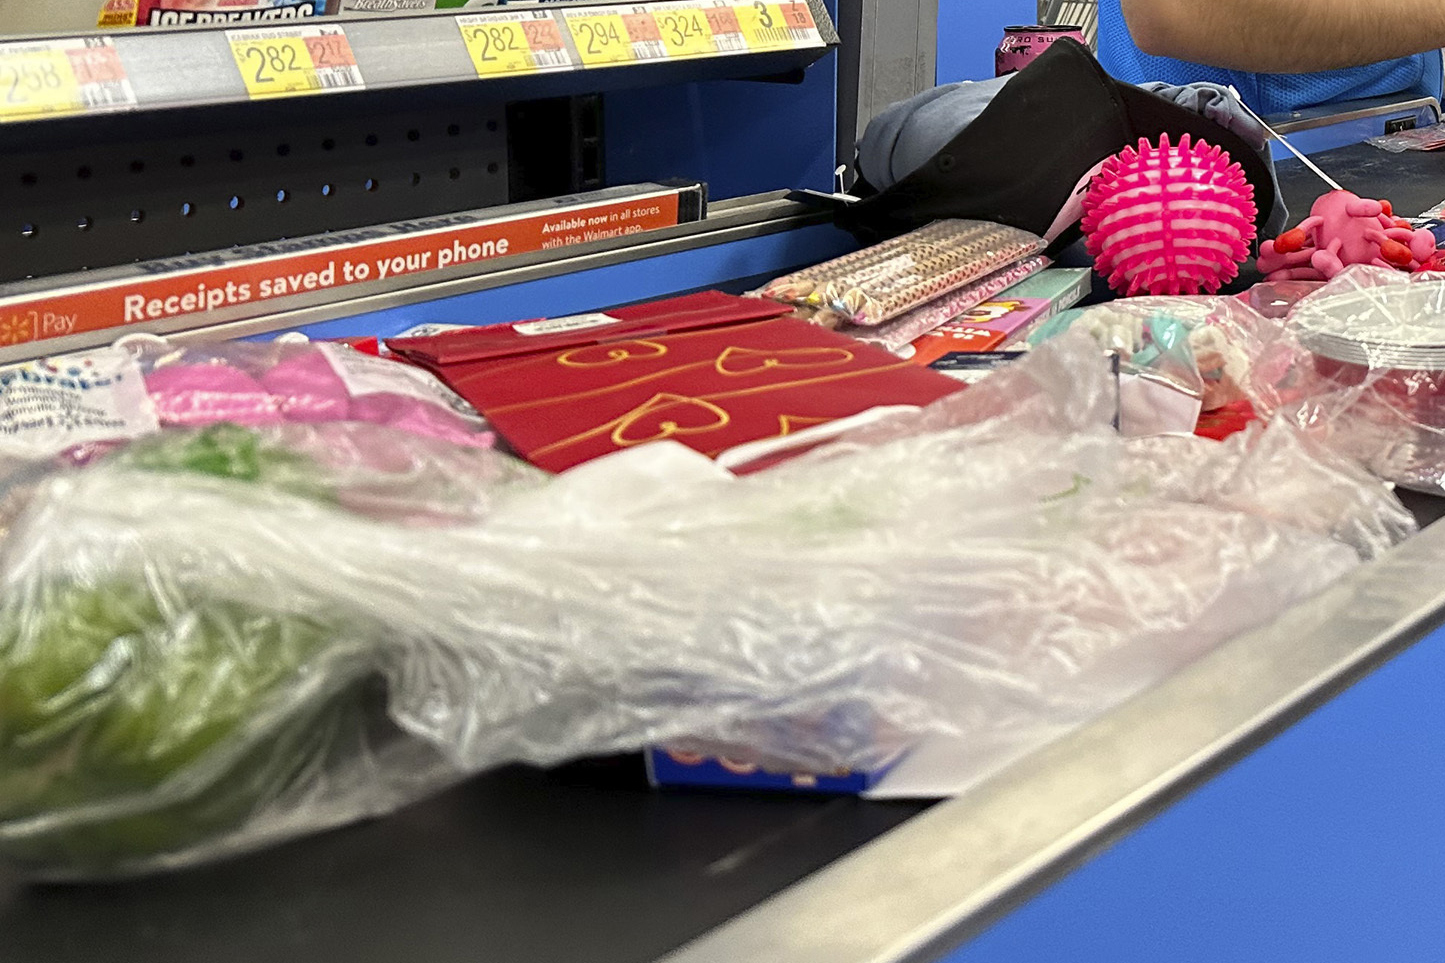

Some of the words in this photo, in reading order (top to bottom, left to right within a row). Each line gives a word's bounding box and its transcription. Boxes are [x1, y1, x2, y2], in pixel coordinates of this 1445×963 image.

[754, 1, 773, 28] 3
[792, 13, 807, 24] 18
[542, 219, 586, 234] Available
[588, 216, 608, 226] now
[610, 213, 618, 222] in
[620, 208, 630, 220] all
[632, 206, 660, 219] stores
[542, 237, 563, 250] with
[565, 233, 581, 245] the
[583, 227, 622, 241] Walmart
[124, 280, 251, 321] Receipts
[258, 261, 336, 298] saved
[343, 261, 370, 282] to
[377, 249, 432, 280] your
[437, 238, 509, 269] phone
[43, 313, 78, 334] Pay
